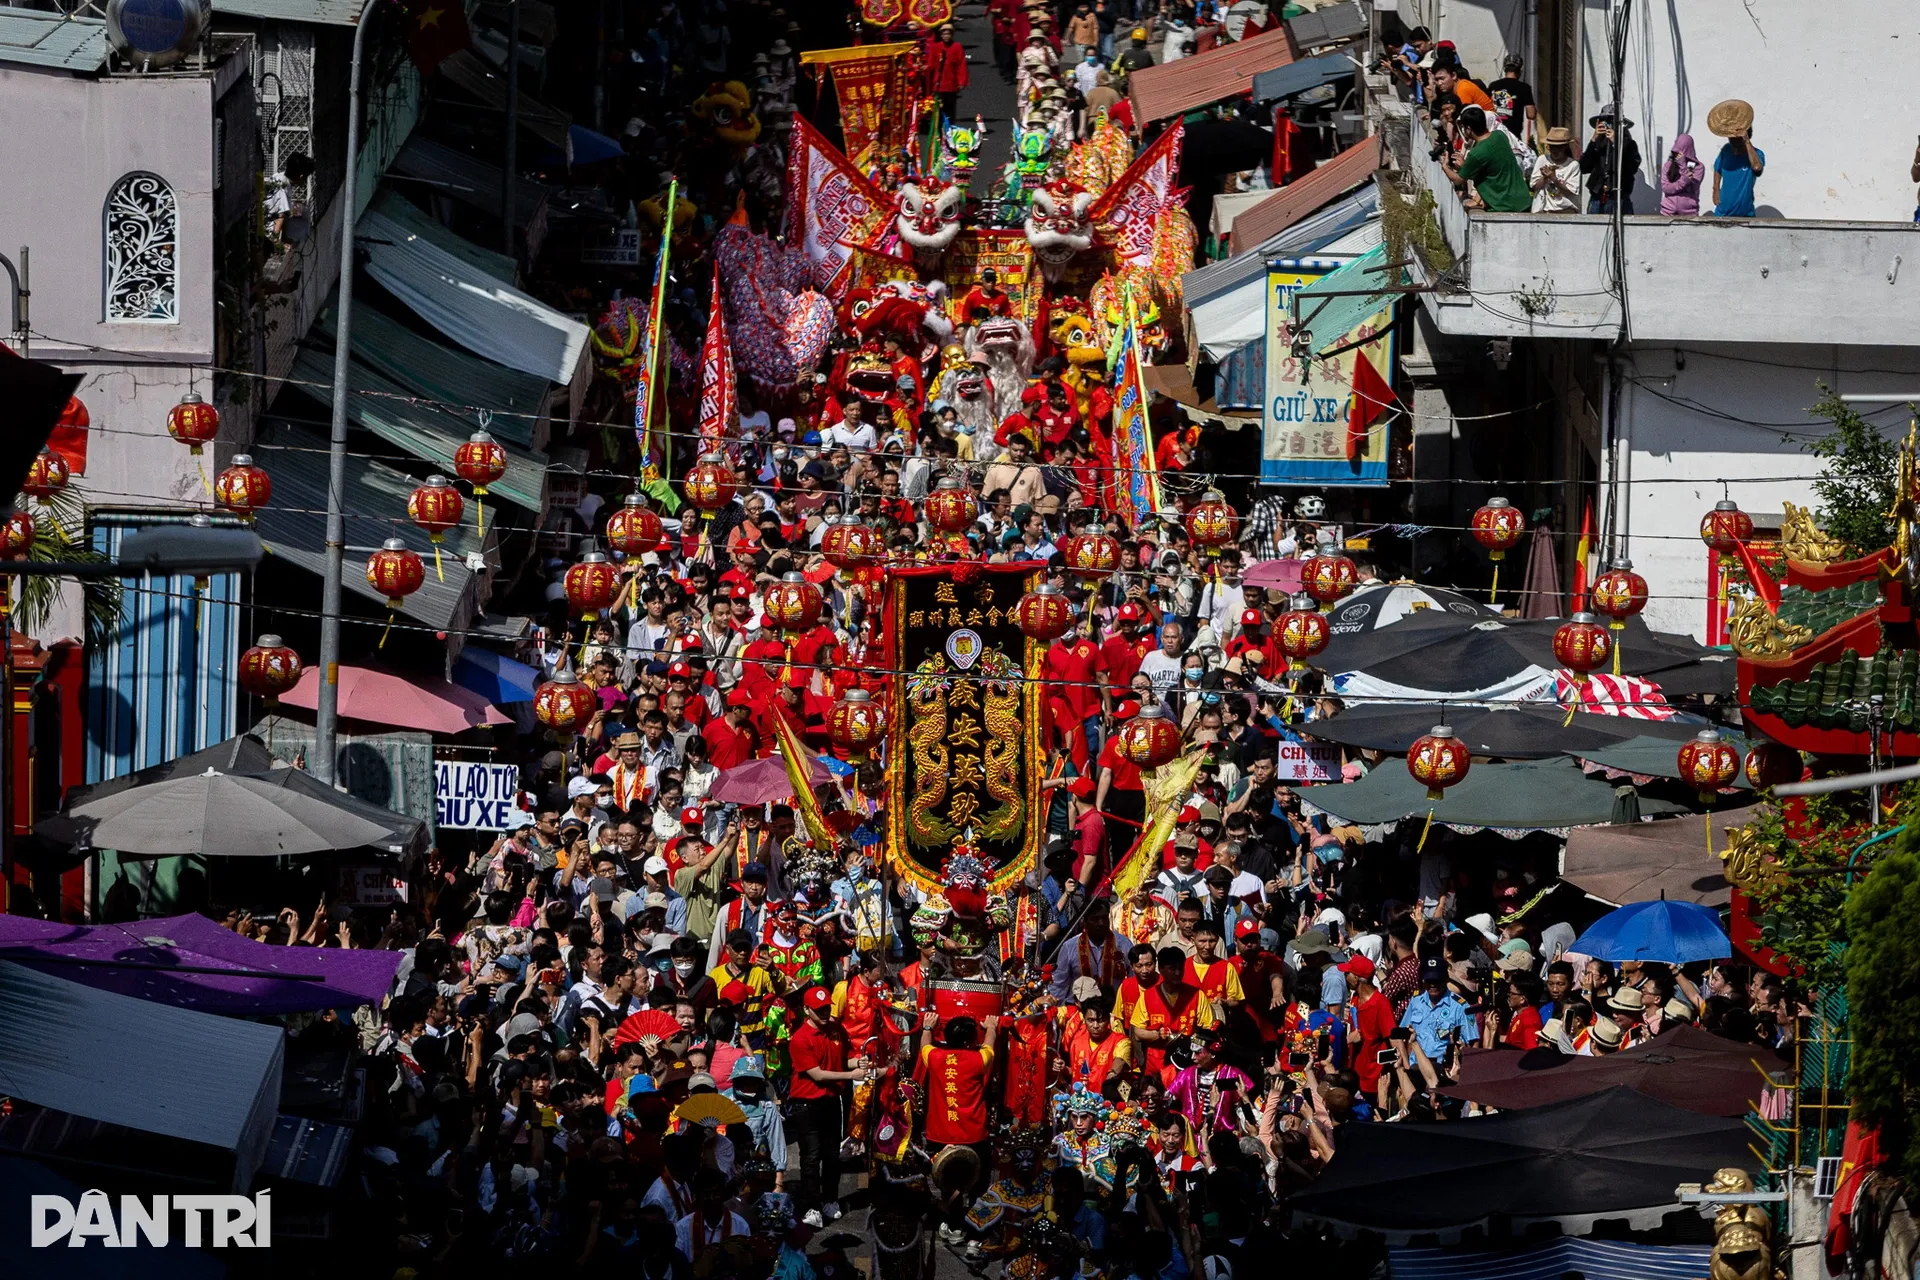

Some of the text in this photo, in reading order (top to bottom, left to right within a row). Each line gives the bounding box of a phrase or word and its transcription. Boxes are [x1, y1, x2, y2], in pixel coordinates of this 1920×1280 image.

[622, 234, 637, 248] XE
[1312, 398, 1337, 423] XE
[1330, 623, 1364, 635] egend
[1151, 670, 1181, 682] MARYLA
[948, 673, 985, 850] 義安英歌
[1281, 746, 1306, 763] CHỊ
[455, 762, 488, 799] LÃO
[475, 800, 512, 828] XE
